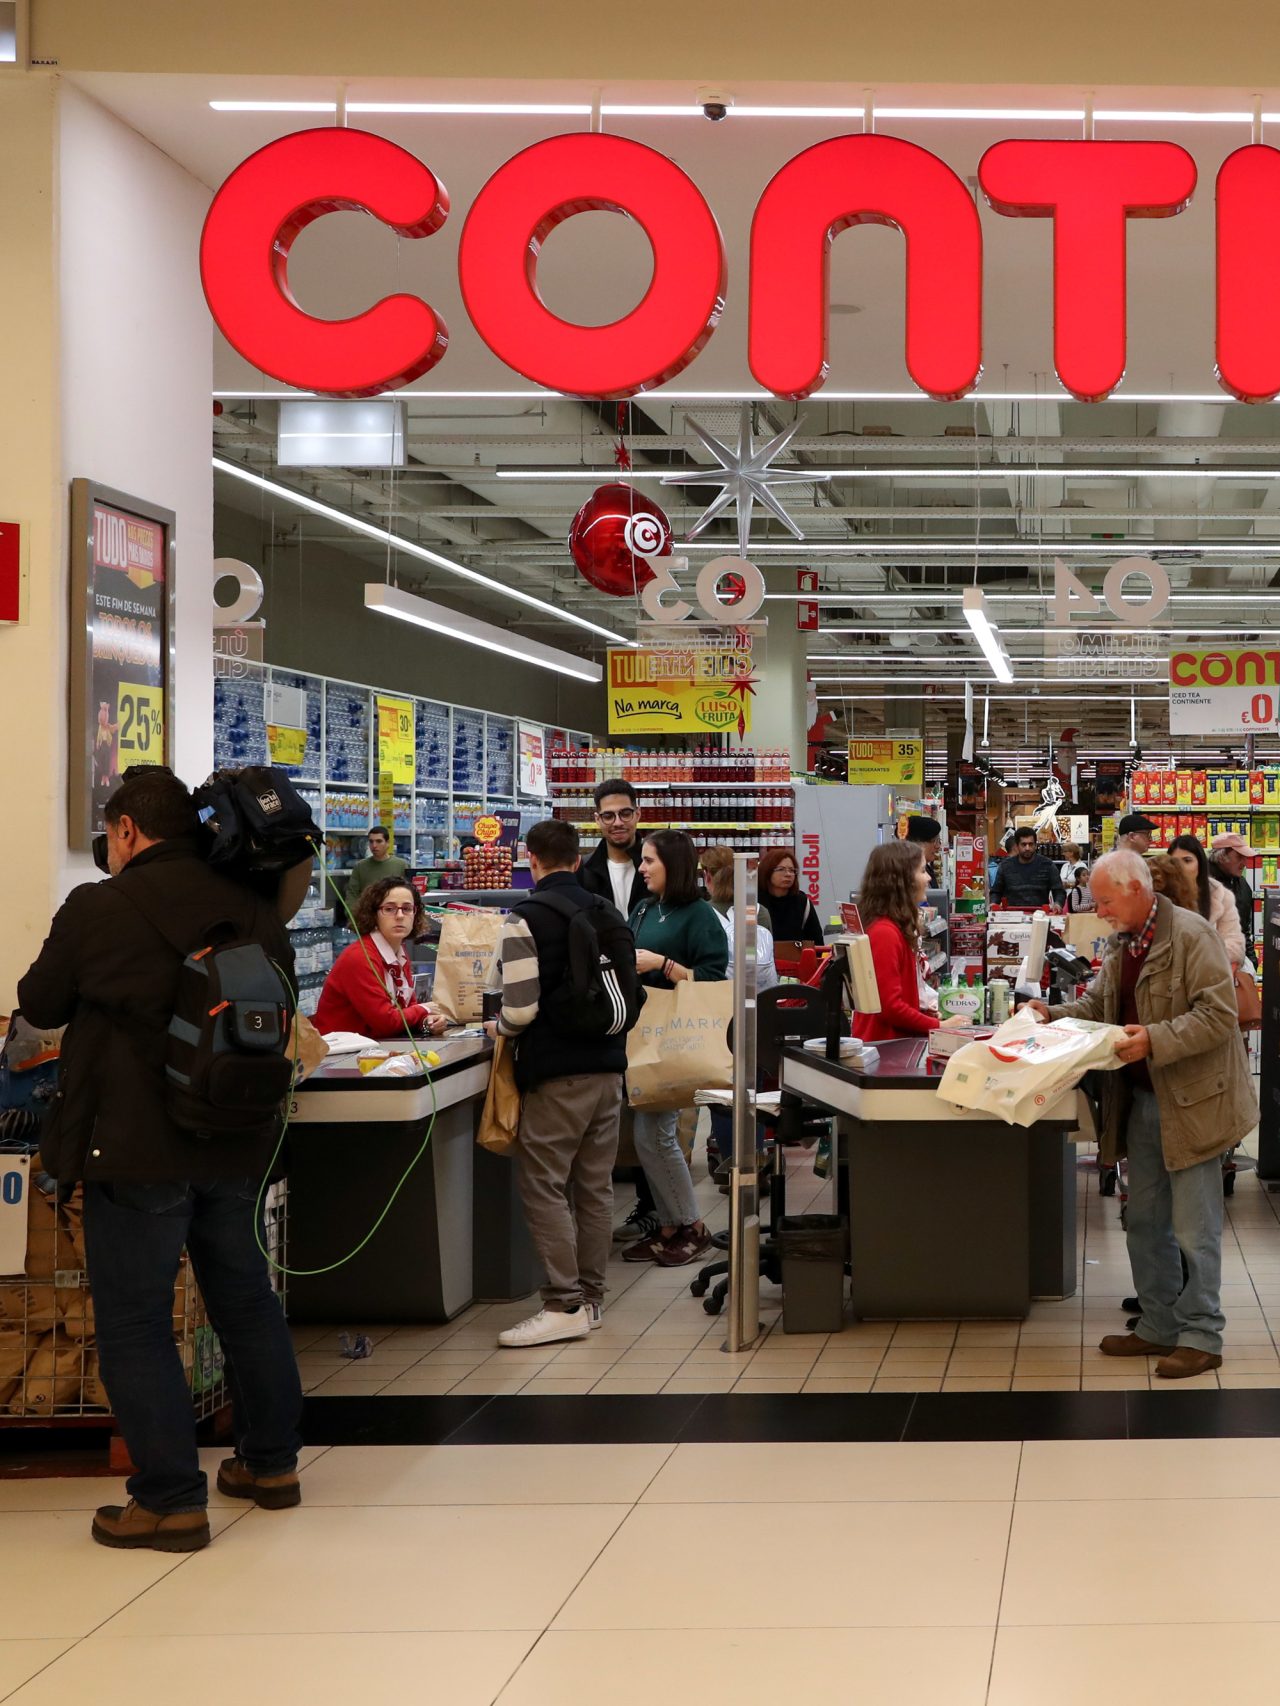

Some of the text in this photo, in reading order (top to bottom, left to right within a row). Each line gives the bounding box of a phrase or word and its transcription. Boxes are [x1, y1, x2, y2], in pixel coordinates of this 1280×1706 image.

[94, 510, 127, 568] TUDO
[95, 593, 156, 617] ESTE FIM DE SEMANA
[614, 655, 657, 683] TUDO
[615, 699, 679, 717] Na marca
[701, 701, 737, 713] LUSO
[120, 694, 162, 751] 25%
[702, 712, 736, 722] FRUTA
[851, 742, 873, 758] TUDO
[476, 828, 498, 836] Chups
[802, 834, 820, 868] Bull
[945, 999, 977, 1007] PEDRAS
[254, 1015, 263, 1029] 3
[290, 1101, 298, 1114] 3
